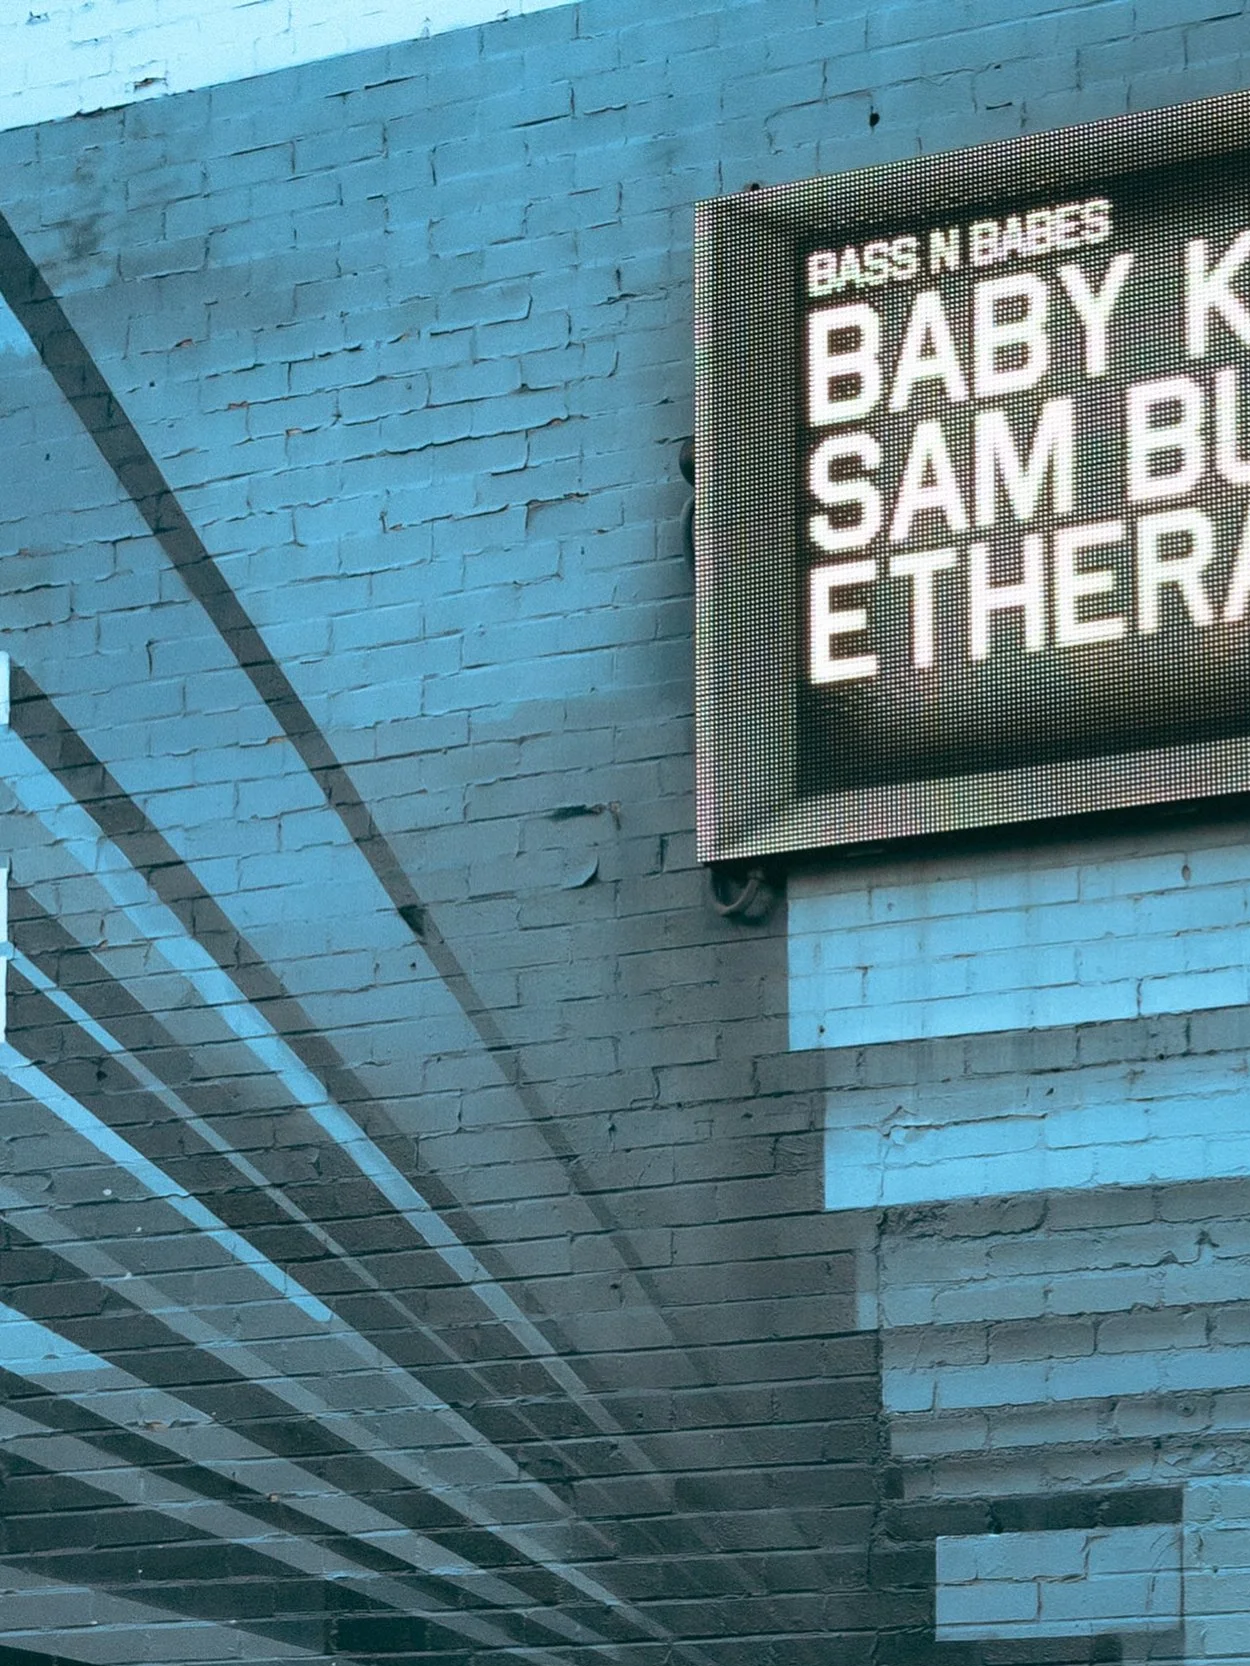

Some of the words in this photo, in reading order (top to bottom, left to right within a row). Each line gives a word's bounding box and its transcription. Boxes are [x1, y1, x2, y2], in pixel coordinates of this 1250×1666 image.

[807, 235, 918, 297] BASS
[929, 228, 962, 274] N
[969, 198, 1113, 264] BABES
[806, 251, 1135, 428] BABY
[807, 395, 1076, 554] SAM
